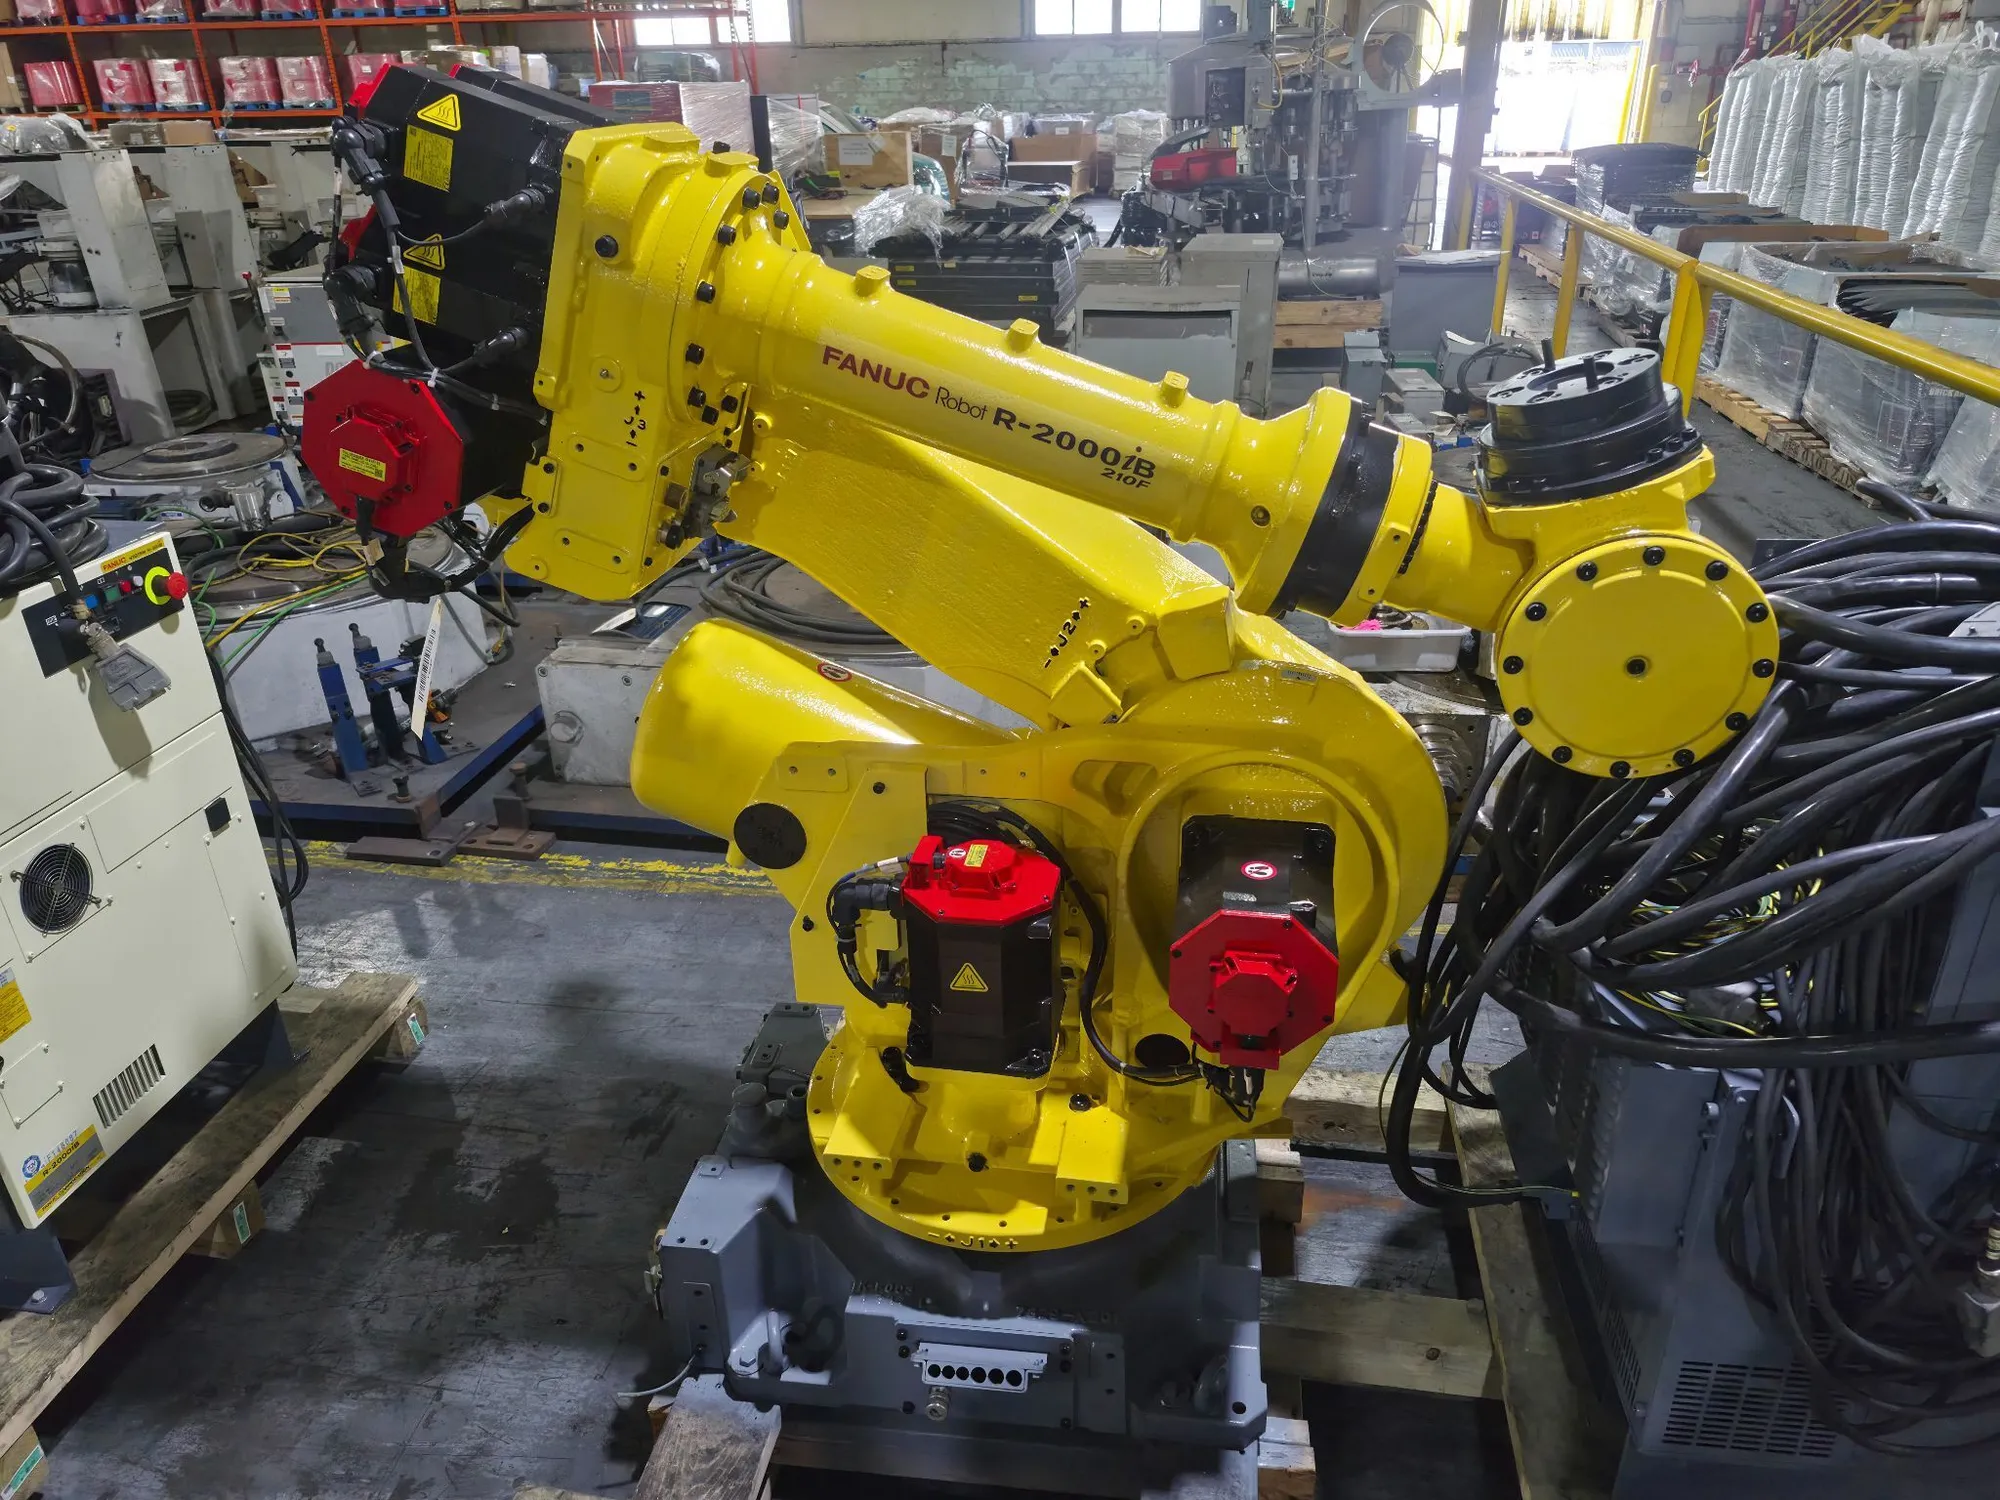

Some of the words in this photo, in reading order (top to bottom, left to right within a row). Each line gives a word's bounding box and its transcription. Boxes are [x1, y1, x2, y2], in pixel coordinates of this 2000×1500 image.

[822, 345, 930, 399] FANUC
[935, 386, 988, 420] Robot
[992, 407, 1156, 479] R-2000iB
[1101, 467, 1151, 489] 210F
